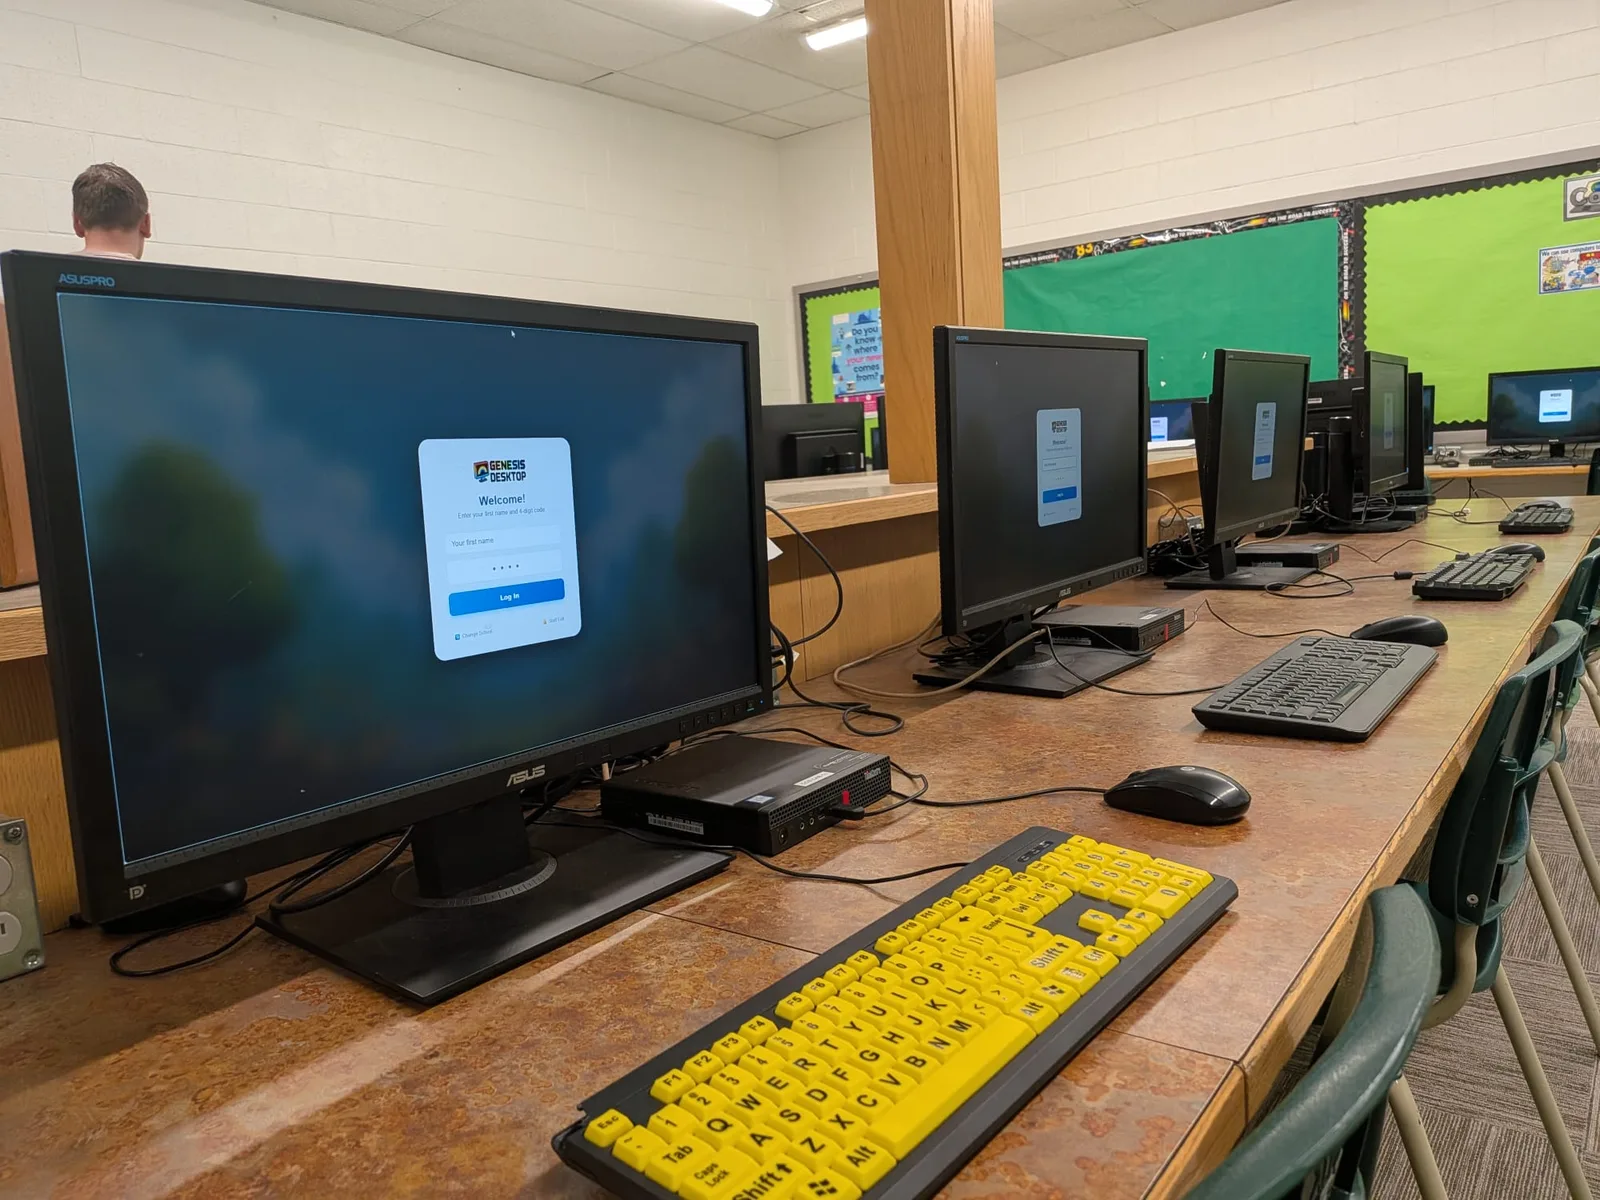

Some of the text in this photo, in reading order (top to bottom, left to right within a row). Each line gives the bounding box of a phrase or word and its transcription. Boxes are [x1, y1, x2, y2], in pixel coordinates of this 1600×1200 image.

[58, 273, 115, 287] ASUSPRO
[852, 326, 878, 336] Do you
[855, 336, 876, 345] know
[854, 345, 878, 354] where
[853, 364, 880, 372] comes
[490, 459, 526, 471] GENESIS
[490, 471, 527, 482] DESKTOP
[478, 494, 526, 506] Welcome!
[458, 512, 471, 520] Enter
[451, 540, 465, 548] Your
[466, 538, 477, 546] first
[500, 594, 512, 602] Log
[506, 764, 546, 787] ASUS
[1030, 947, 1065, 969] Shift
[833, 968, 848, 976] F7
[930, 962, 945, 972] P
[911, 976, 929, 986] O
[891, 992, 907, 1000] I
[946, 986, 967, 994] L
[786, 996, 802, 1006] F5
[924, 999, 948, 1011] K
[1020, 998, 1044, 1016] Alt
[866, 1005, 887, 1017] U
[748, 1019, 766, 1031] F4
[843, 1020, 863, 1032] Y
[907, 1014, 923, 1026] J
[947, 1019, 972, 1033] M
[721, 1037, 739, 1049] F3
[820, 1038, 840, 1050] T
[881, 1031, 905, 1044] H
[928, 1036, 951, 1050] N
[694, 1055, 712, 1068] F2
[859, 1050, 880, 1062] G
[904, 1055, 928, 1068] B
[793, 1058, 817, 1071] R
[663, 1074, 682, 1087] F1
[832, 1067, 850, 1082] F
[878, 1072, 902, 1087] V
[766, 1076, 790, 1090] E
[696, 1096, 712, 1106] 2
[805, 1088, 828, 1103] D
[856, 1094, 878, 1108] C
[735, 1094, 762, 1111] W
[779, 1108, 802, 1123] S
[828, 1114, 855, 1130] X
[597, 1116, 619, 1130] Esc
[706, 1118, 734, 1132] Q
[750, 1132, 774, 1148] A
[800, 1137, 826, 1154] Z
[662, 1144, 694, 1164] Tab
[846, 1145, 878, 1168] Alt
[693, 1162, 719, 1181] Caps
[705, 1169, 731, 1188] Lock
